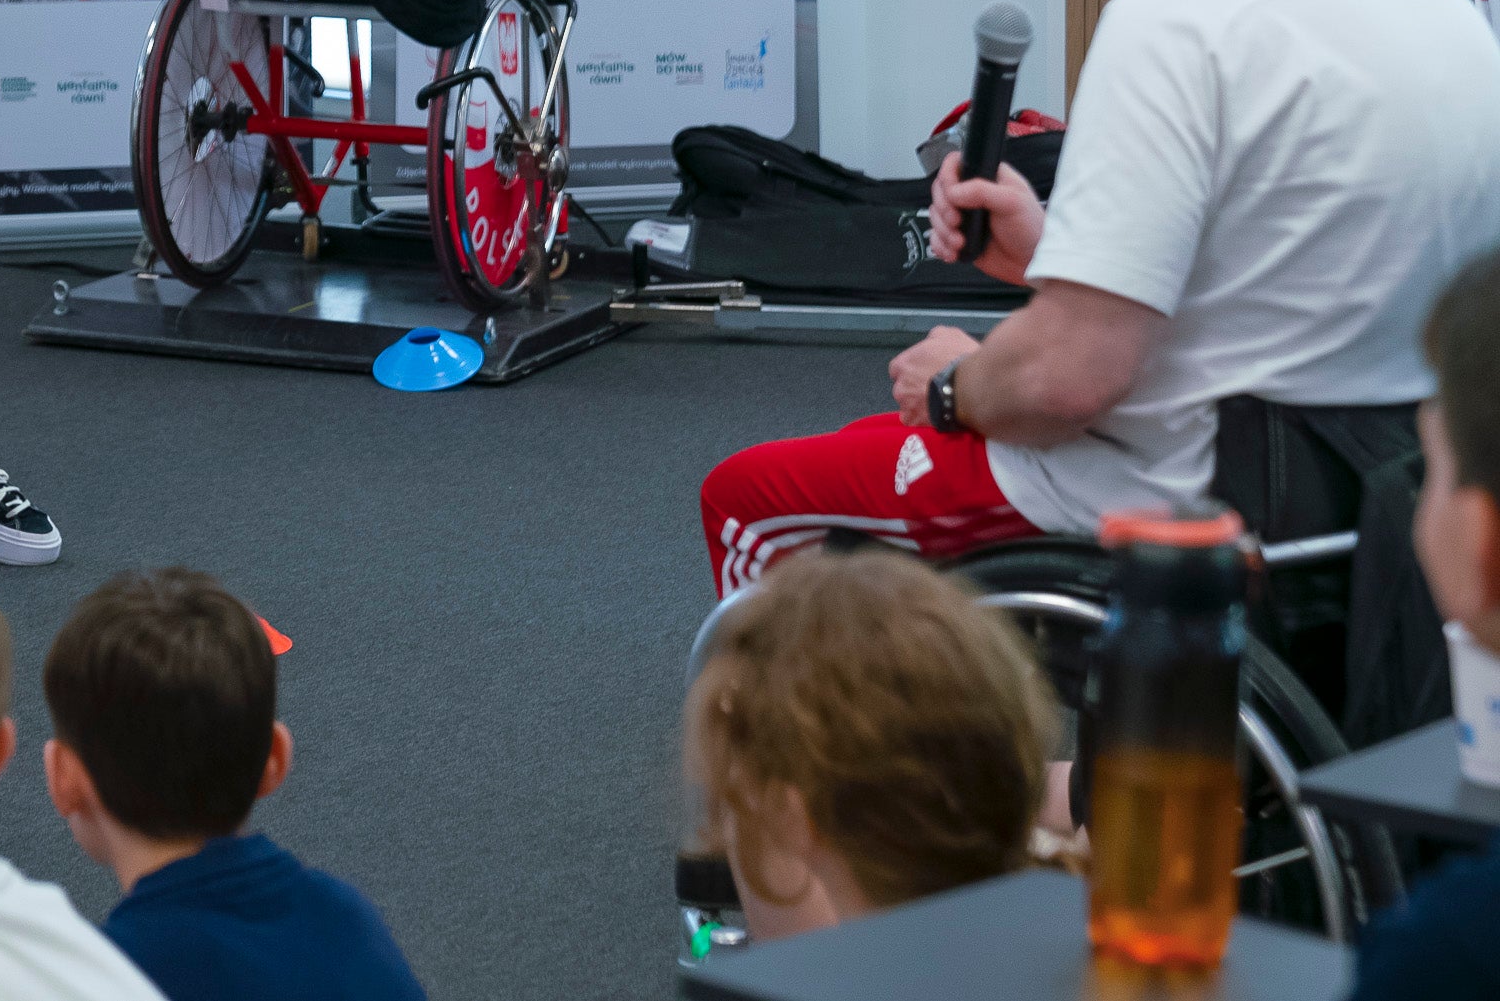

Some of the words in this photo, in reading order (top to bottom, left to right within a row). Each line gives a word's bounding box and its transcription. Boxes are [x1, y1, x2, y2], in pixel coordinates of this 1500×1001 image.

[656, 51, 686, 63] MÓW
[576, 60, 634, 74] Mentalnie
[656, 65, 673, 75] DO
[675, 64, 703, 74] MNIE
[589, 73, 621, 85] równi
[57, 78, 119, 93] Mentalnie
[71, 92, 105, 105] równi
